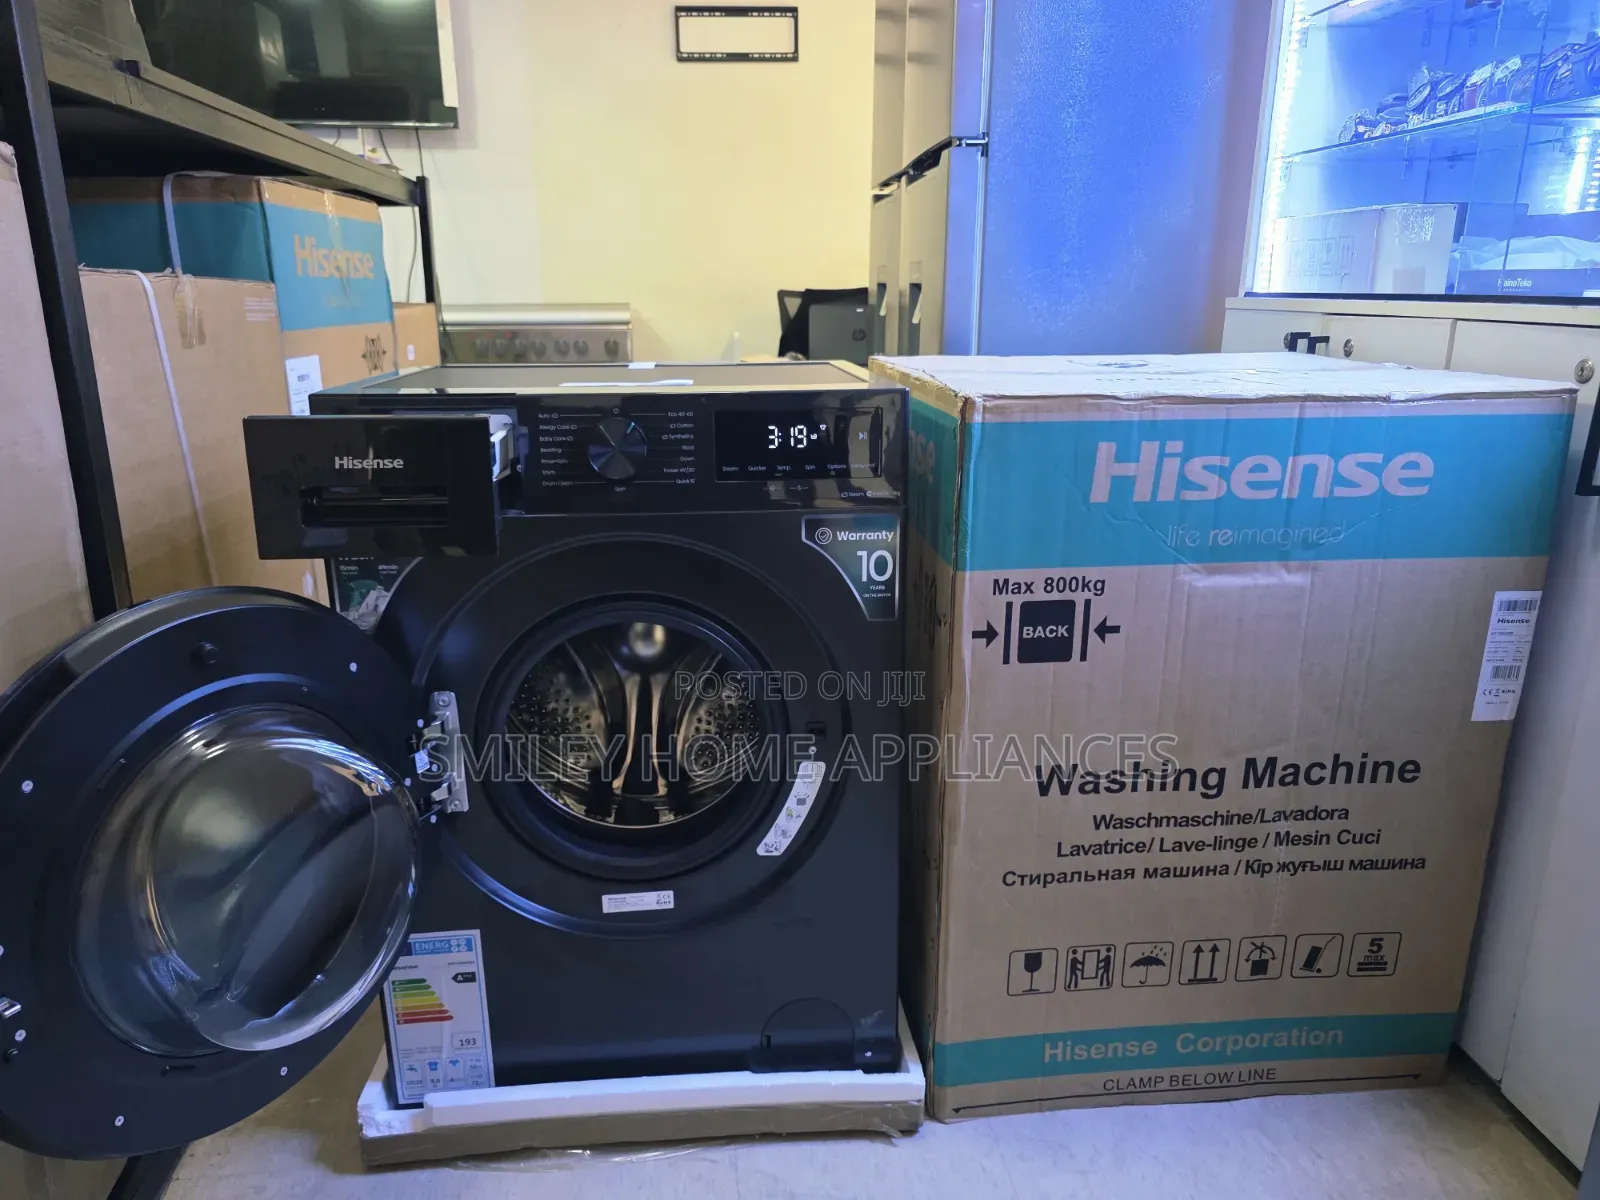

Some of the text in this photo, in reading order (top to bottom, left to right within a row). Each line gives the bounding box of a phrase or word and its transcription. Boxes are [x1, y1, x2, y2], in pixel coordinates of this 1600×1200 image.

[293, 234, 375, 280] Hisense
[767, 425, 807, 449] 3:19
[334, 456, 404, 469] Hisense
[1089, 440, 1435, 503] Hisense
[836, 530, 895, 542] Warranty
[1167, 521, 1346, 550] life reimagined
[856, 549, 894, 582] 10
[992, 576, 1106, 597] Max 800kg
[1022, 625, 1069, 639] BACK
[1035, 752, 1422, 800] Washing Machine
[1092, 805, 1350, 831] Waschmaschine/Lavadora
[1056, 837, 1155, 858] Lavatrice/
[1159, 835, 1258, 853] Lave-linge
[1273, 830, 1330, 848] Mesin
[1336, 828, 1382, 846] Cuci
[1002, 868, 1136, 888] Стиральная
[1143, 862, 1230, 880] машина
[1348, 857, 1427, 872] машина
[415, 939, 449, 951] ENERG
[1367, 937, 1384, 954] 5
[1363, 954, 1386, 962] max
[459, 1037, 477, 1047] 193
[1043, 1025, 1344, 1063] Hisense Corporation
[1102, 1068, 1277, 1092] CLAMP BELOW LINE
